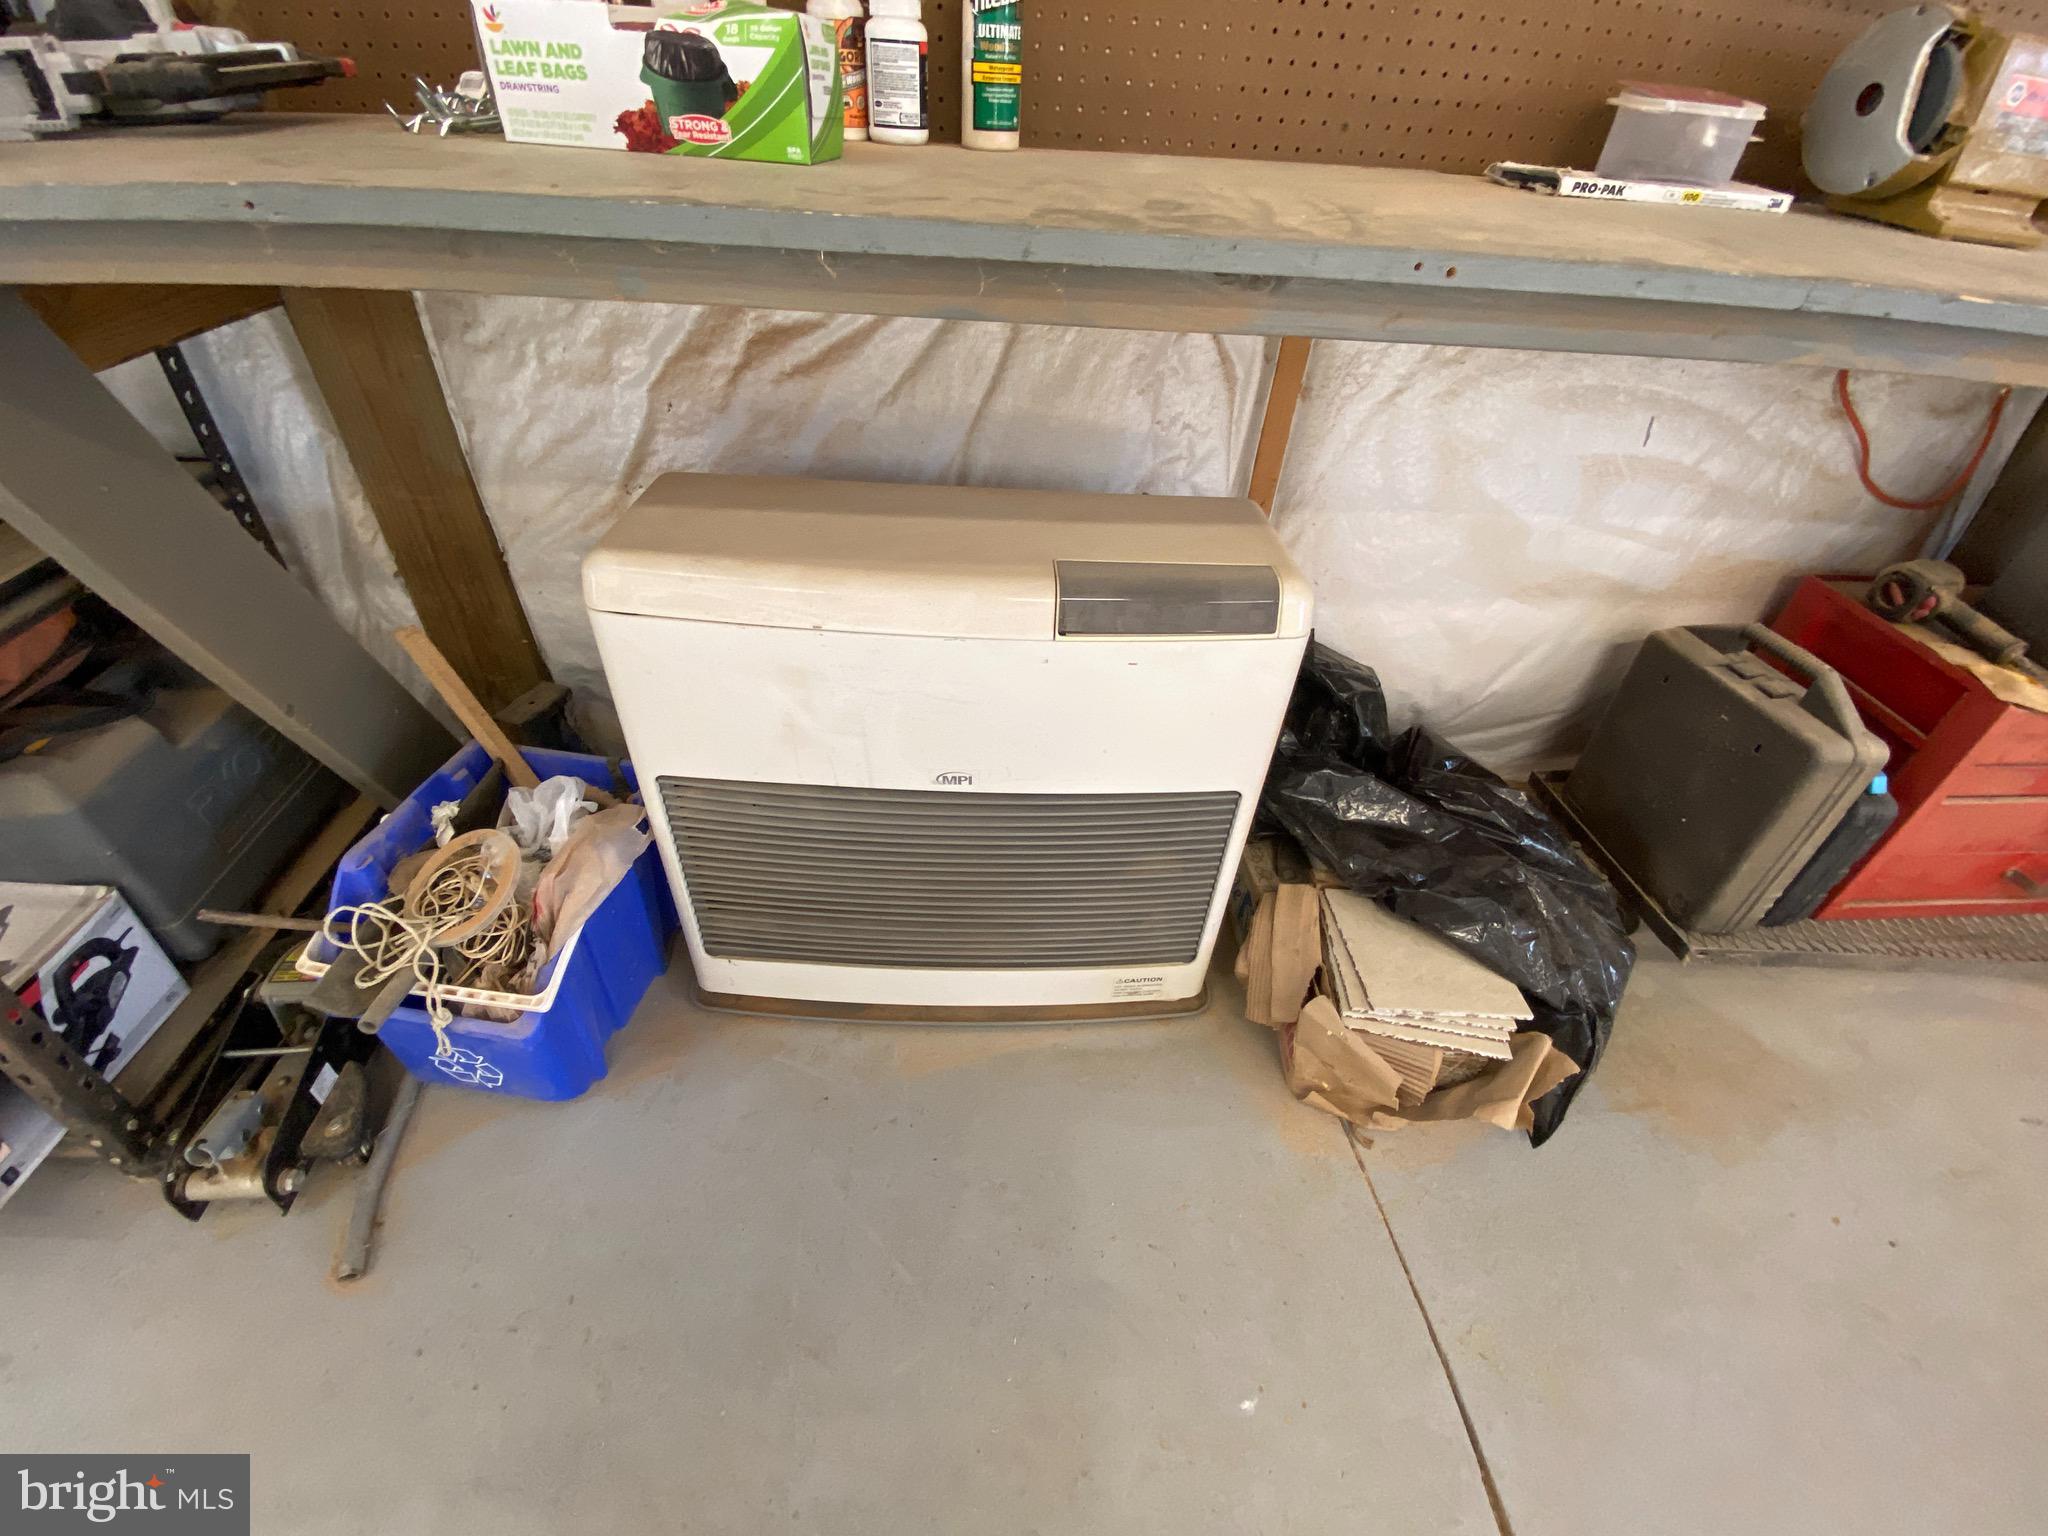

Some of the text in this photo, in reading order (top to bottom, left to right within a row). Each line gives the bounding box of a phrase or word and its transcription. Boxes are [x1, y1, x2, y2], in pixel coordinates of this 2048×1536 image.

[489, 38, 583, 59] LAWN AND
[494, 60, 588, 80] LEAF BAGS
[499, 81, 560, 94] DRAWSTRING
[671, 119, 719, 131] STRONG
[942, 775, 973, 785] MPI
[1124, 976, 1163, 984] CAUTION
